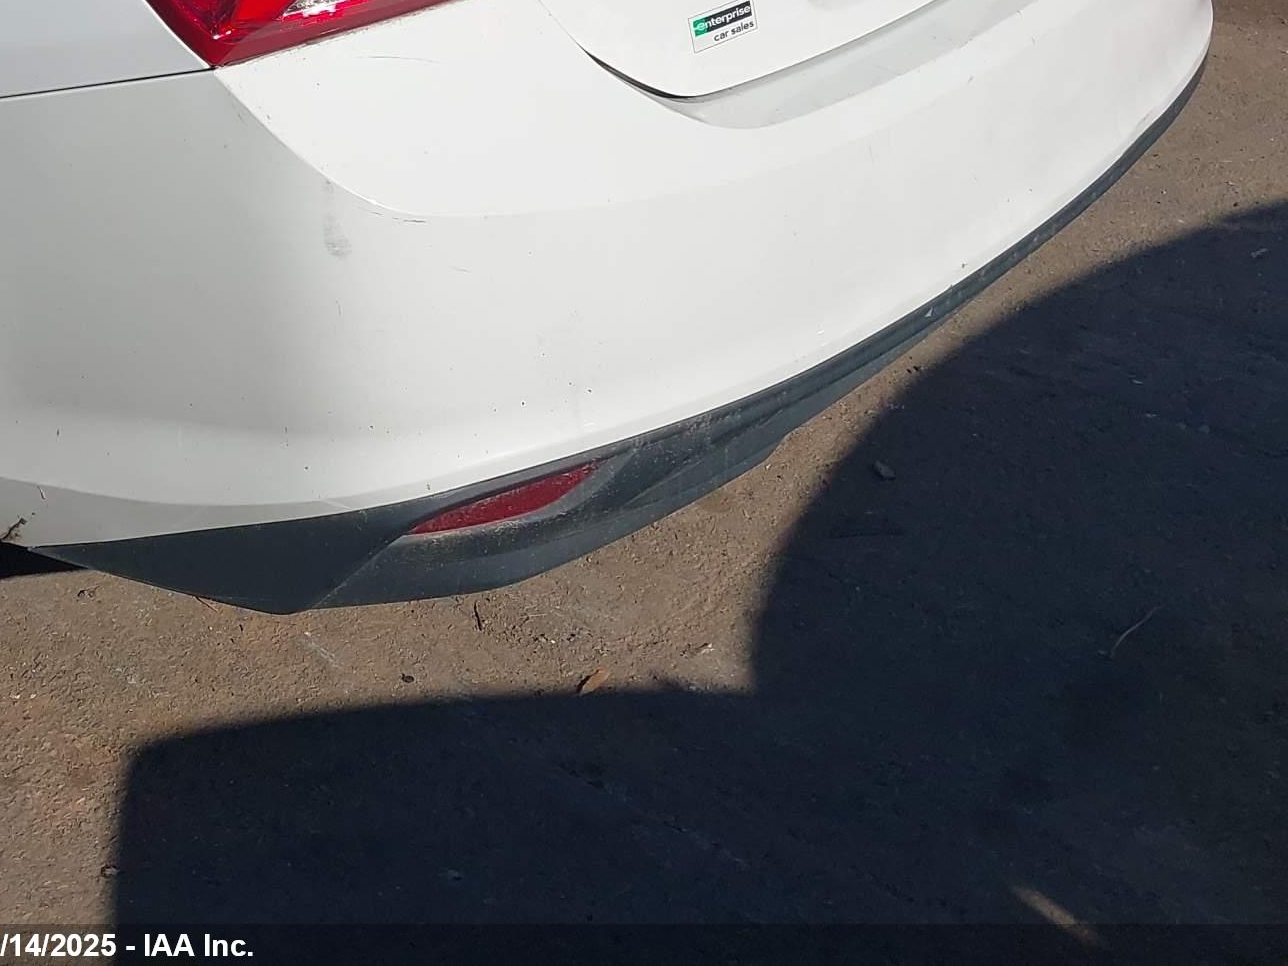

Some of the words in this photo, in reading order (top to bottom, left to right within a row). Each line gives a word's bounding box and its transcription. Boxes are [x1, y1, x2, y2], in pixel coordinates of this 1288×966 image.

[695, 5, 751, 31] enterprise
[713, 30, 729, 42] car
[731, 20, 755, 36] sales
